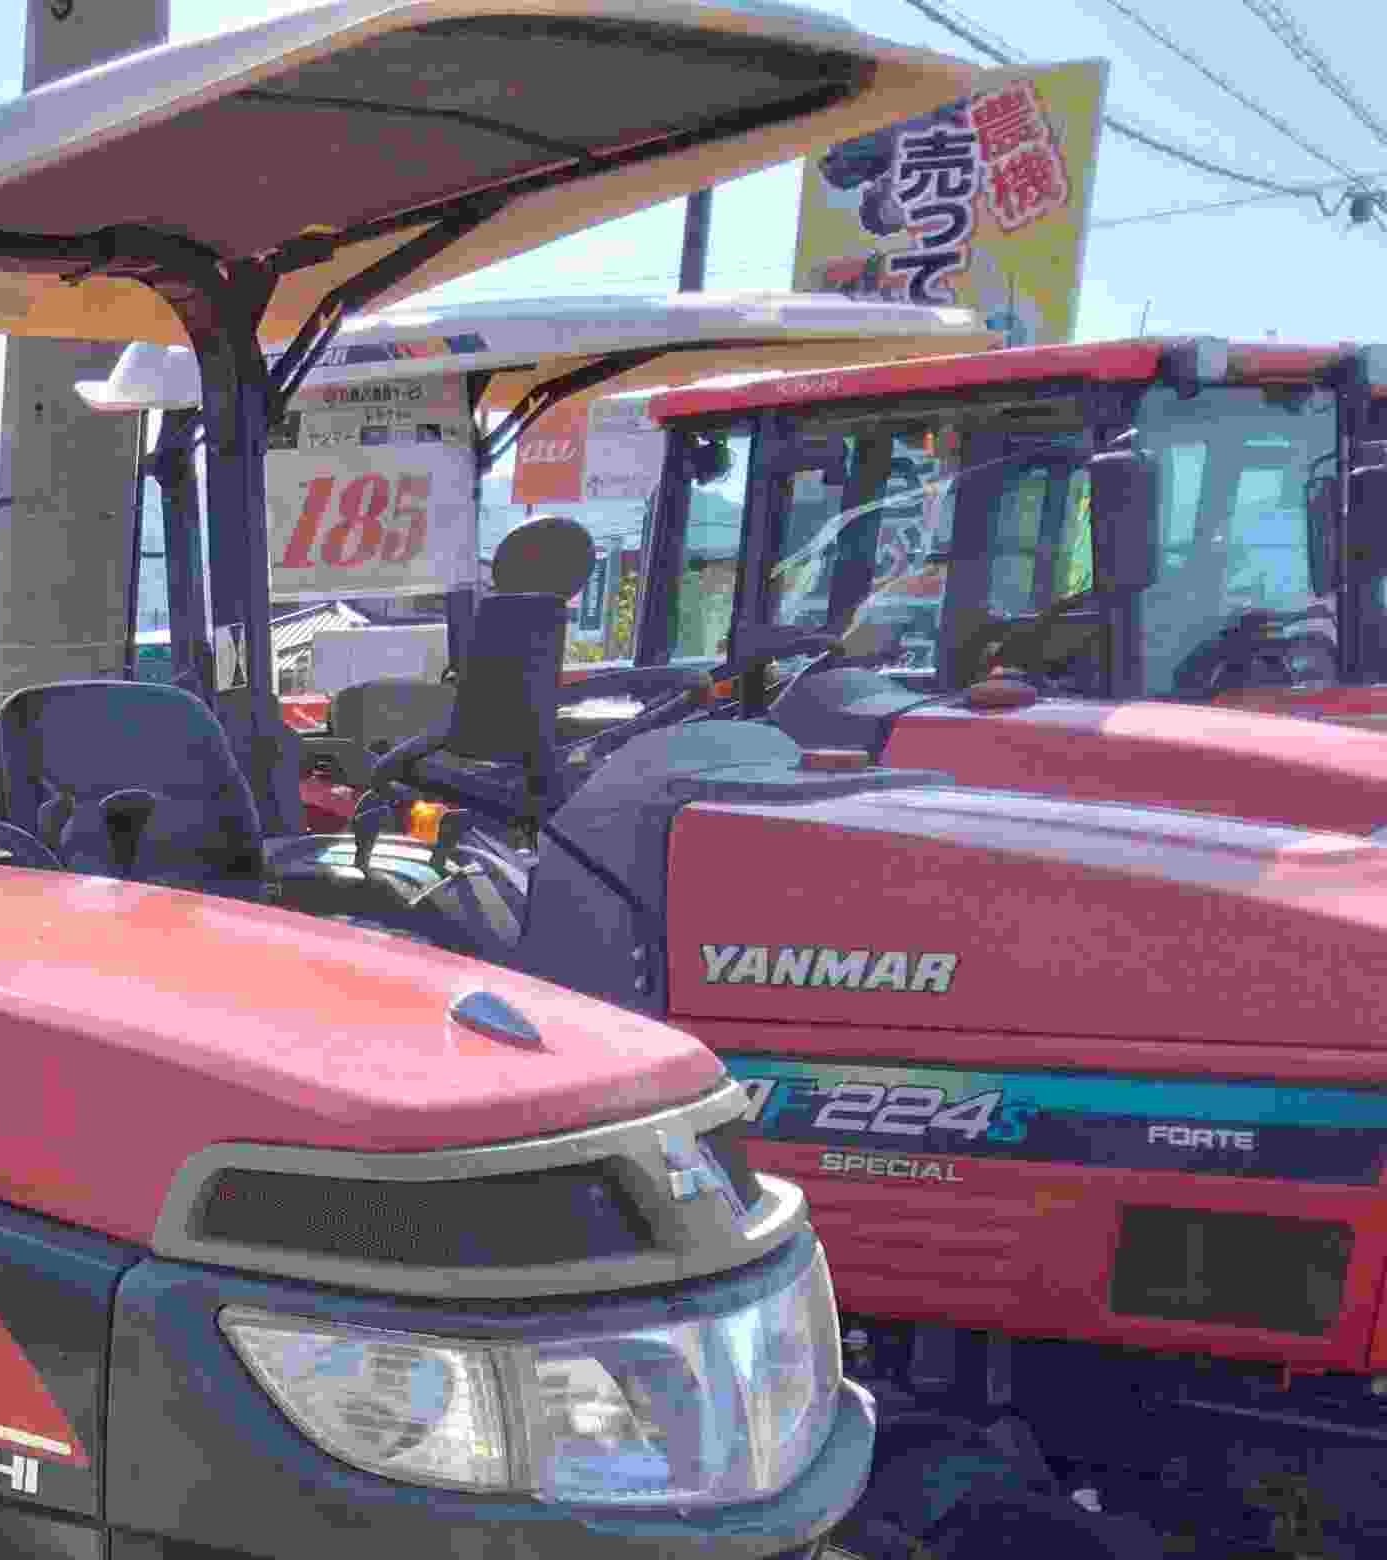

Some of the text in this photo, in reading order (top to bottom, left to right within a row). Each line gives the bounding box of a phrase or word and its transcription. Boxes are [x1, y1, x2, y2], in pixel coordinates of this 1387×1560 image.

[890, 128, 975, 304] 売って
[282, 472, 428, 568] 185
[700, 944, 959, 992] YANMAR
[1147, 1124, 1255, 1151] FORTE
[820, 1152, 964, 1182] SPECIAL
